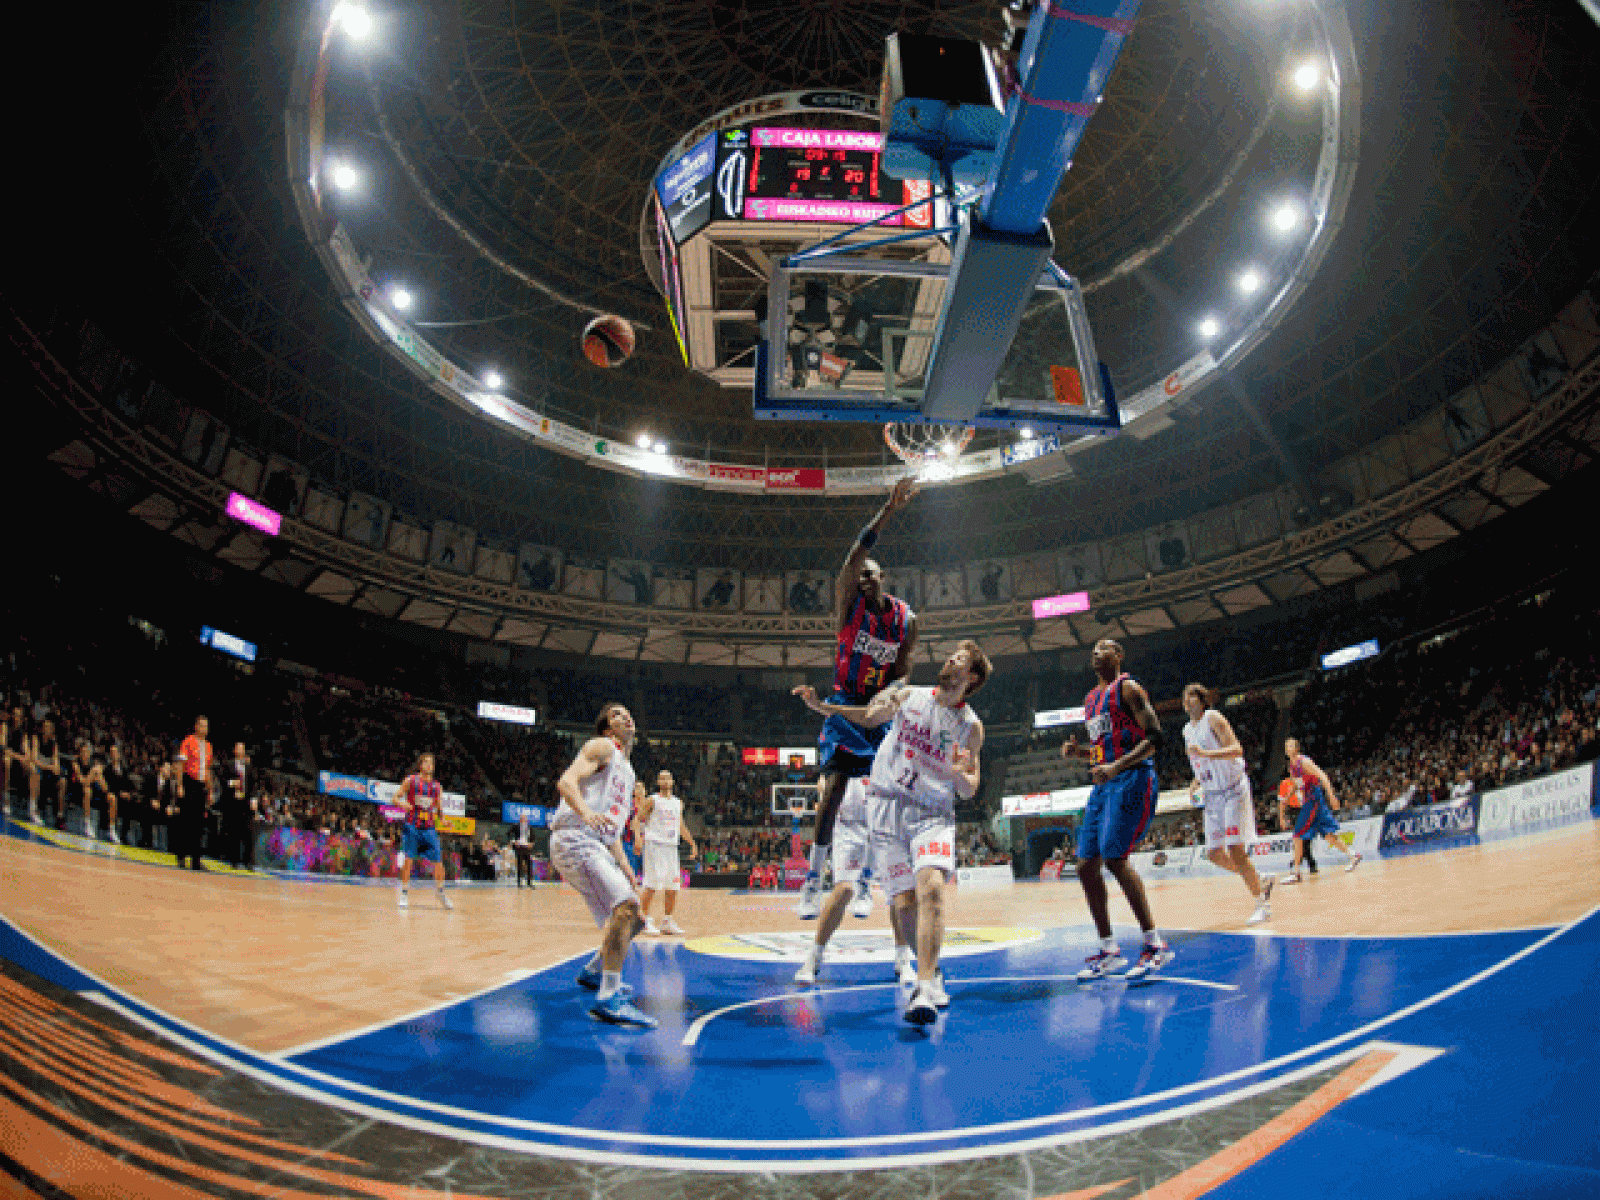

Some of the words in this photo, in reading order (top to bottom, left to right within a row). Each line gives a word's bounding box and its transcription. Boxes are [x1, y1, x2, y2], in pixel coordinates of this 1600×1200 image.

[781, 131, 821, 147] CAJA
[863, 667, 885, 686] 21
[1385, 803, 1475, 841] AQUABONA
